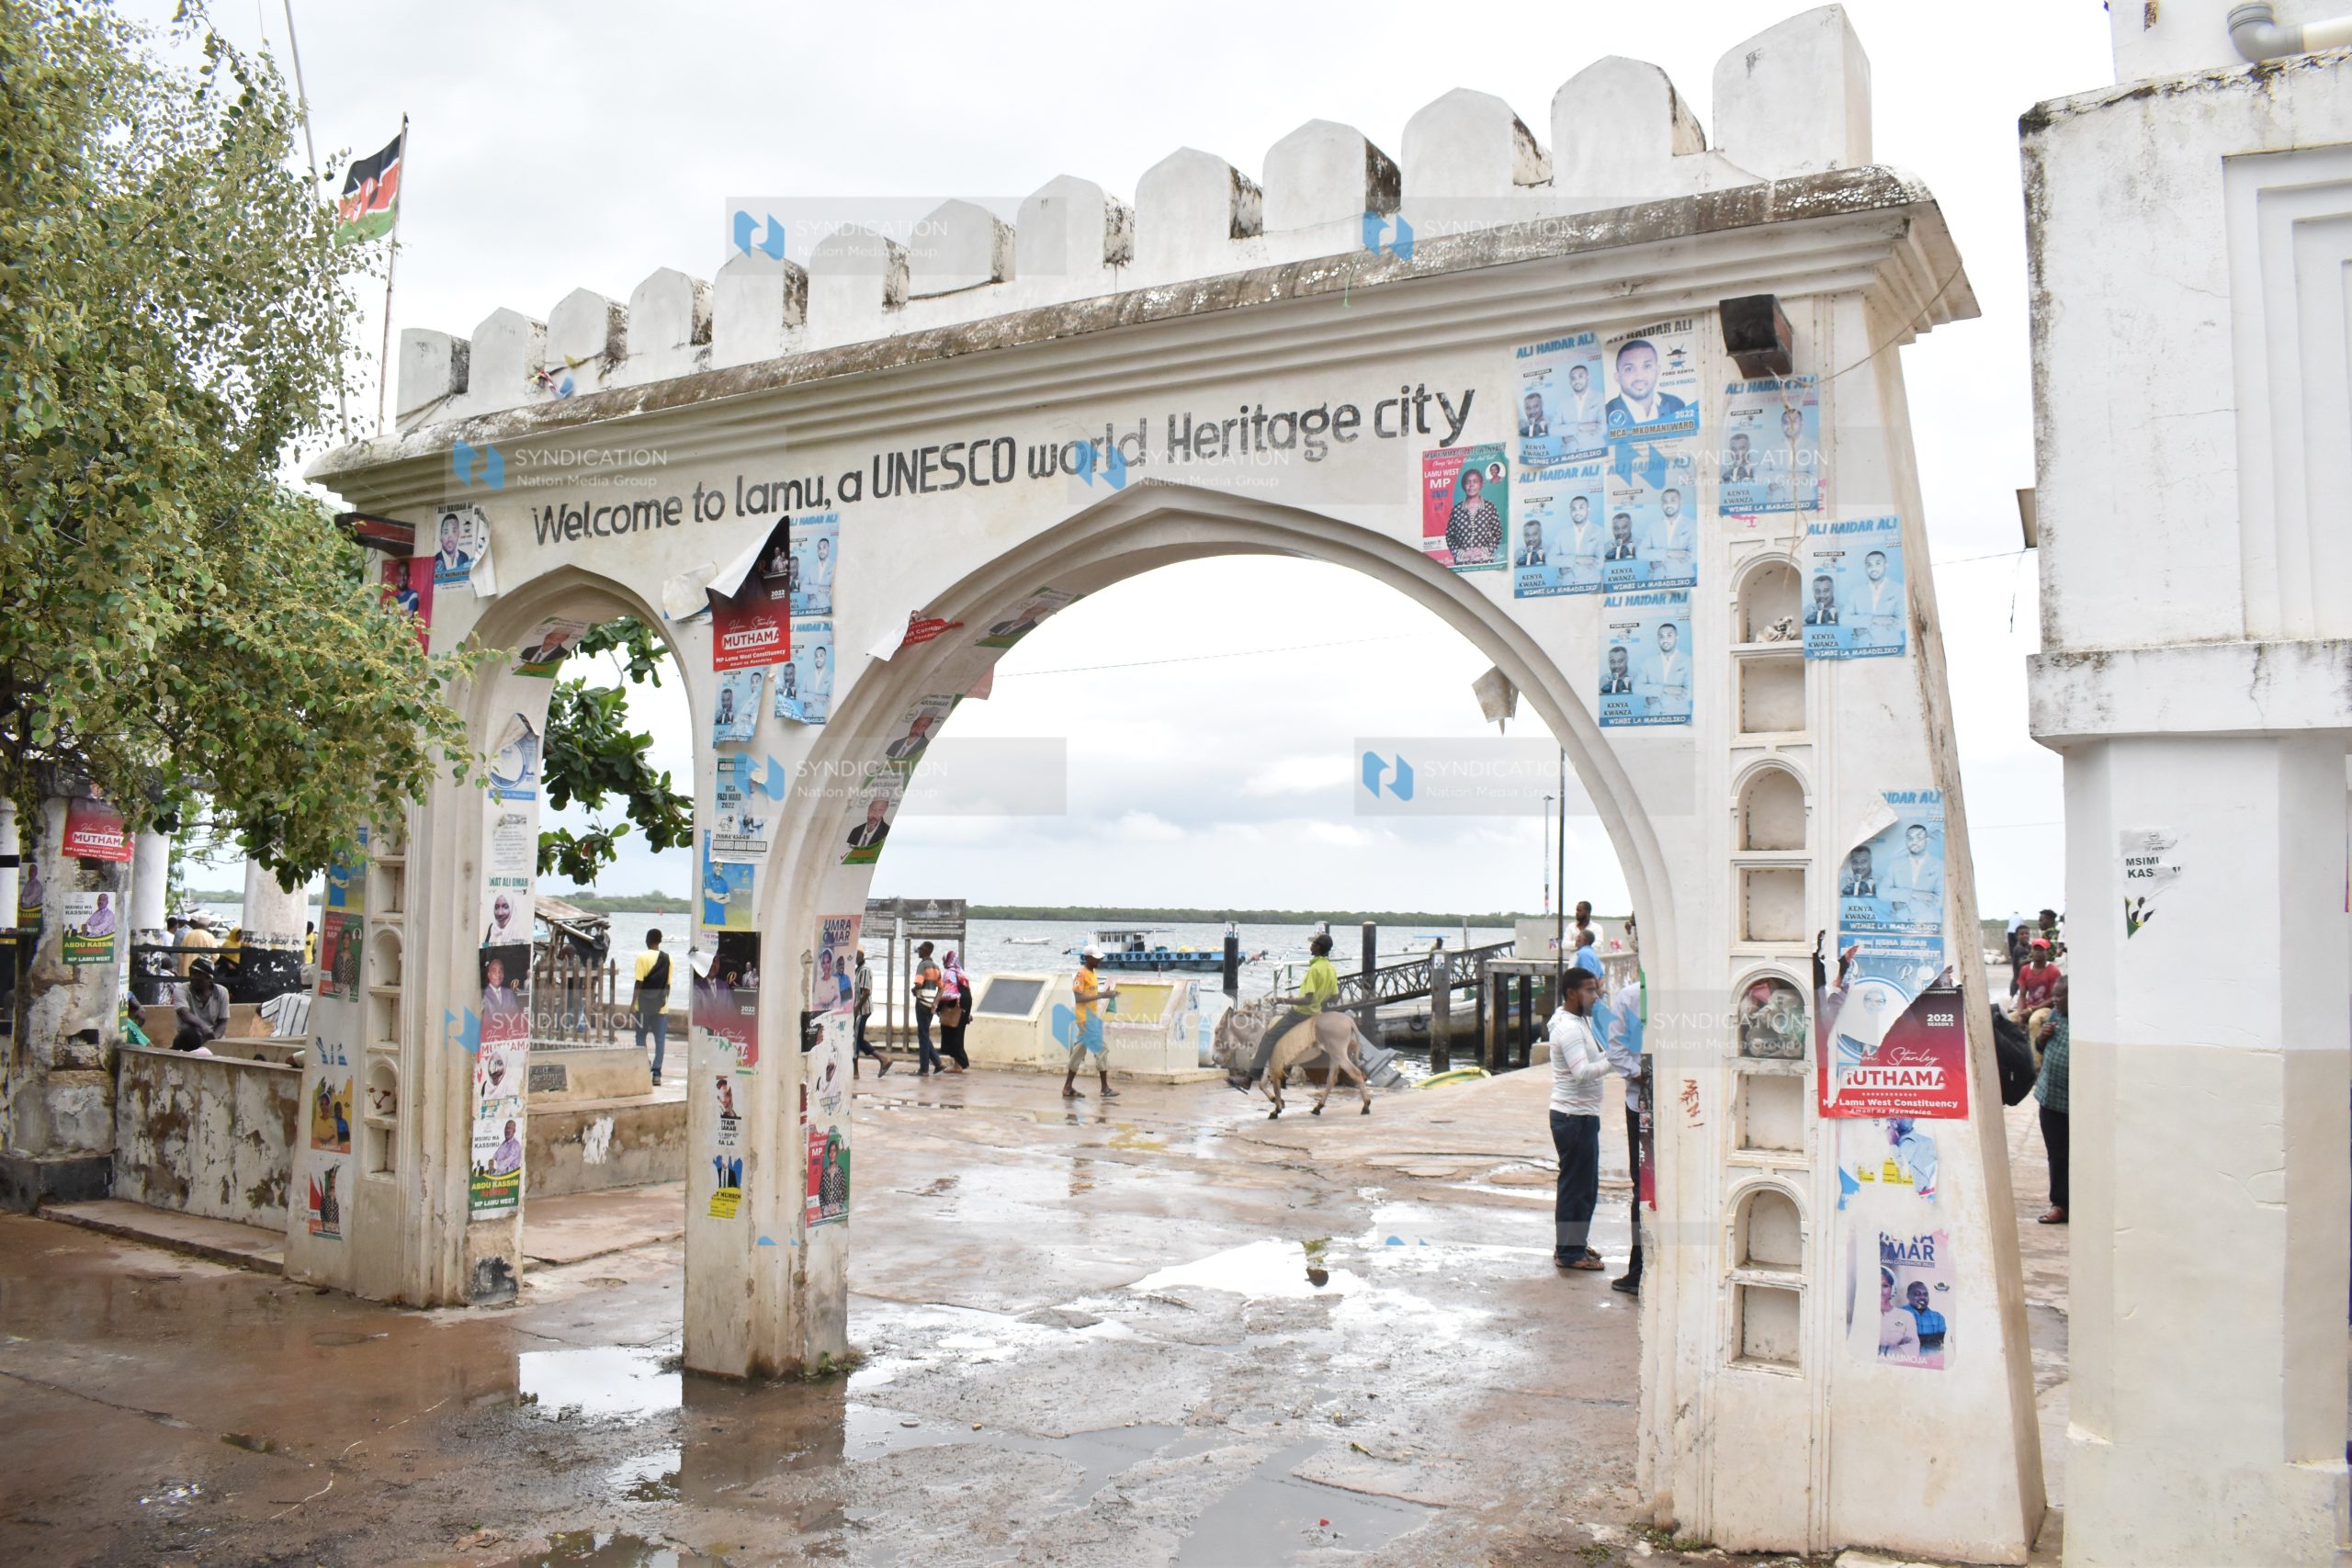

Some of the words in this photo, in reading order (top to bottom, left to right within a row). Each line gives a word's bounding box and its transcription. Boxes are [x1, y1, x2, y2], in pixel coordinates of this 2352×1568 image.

[1625, 321, 1672, 340] HAIDAR
[1674, 319, 1692, 332] ALI
[1516, 345, 1533, 359] ALI
[1536, 337, 1575, 355] HAIDAR
[1577, 332, 1595, 347] ALI
[1725, 383, 1745, 394] ALI
[1675, 410, 1694, 419] 2022
[1669, 421, 1695, 432] WARD
[532, 504, 683, 546] Welcome
[694, 482, 726, 524] to
[838, 470, 863, 504] a
[872, 435, 1016, 499] UNESCO
[1027, 417, 1147, 479] world
[1167, 402, 1361, 463] Heritage
[1374, 383, 1476, 449] city
[1424, 469, 1442, 478] LAMU
[1443, 468, 1459, 476] WEST
[1519, 471, 1536, 484] ALI
[1539, 467, 1577, 481] HAIDAR
[1580, 464, 1600, 478] ALI
[1430, 478, 1451, 489] MP
[1807, 523, 1826, 536] ALI
[1829, 520, 1875, 534] HAIDAR
[1877, 517, 1897, 530] ALI
[1648, 579, 1690, 588] MABADILIKO
[1523, 588, 1545, 596] WIMBI
[1557, 584, 1598, 594] MABADILIKO
[1604, 596, 1623, 607] ALI
[1625, 593, 1667, 606] HAIDAR
[1669, 592, 1689, 604] ALI
[723, 630, 779, 649] MUTHAMA
[725, 654, 739, 662] Lamu
[752, 649, 786, 659] Constituency
[1851, 647, 1899, 656] MABADILIKO
[1644, 716, 1686, 724] MABADILIKO
[1919, 791, 1941, 804] ALI
[74, 833, 120, 845] MUTHAM
[503, 877, 511, 886] ALI
[824, 919, 852, 931] UMRA
[327, 931, 337, 939] MP
[823, 931, 850, 942] OMAR
[1927, 1013, 1953, 1021] 2022
[1887, 1047, 1939, 1066] Stanley
[1848, 1070, 1947, 1087] UTHAMA
[1868, 1099, 1892, 1107] West
[1894, 1099, 1958, 1108] Constituency
[811, 1147, 822, 1156] MP
[471, 1181, 492, 1190] ABDU
[492, 1179, 519, 1189] KASSIM
[1887, 1242, 1935, 1261] MAR
[1879, 1352, 1928, 1364] AMUMOJA
